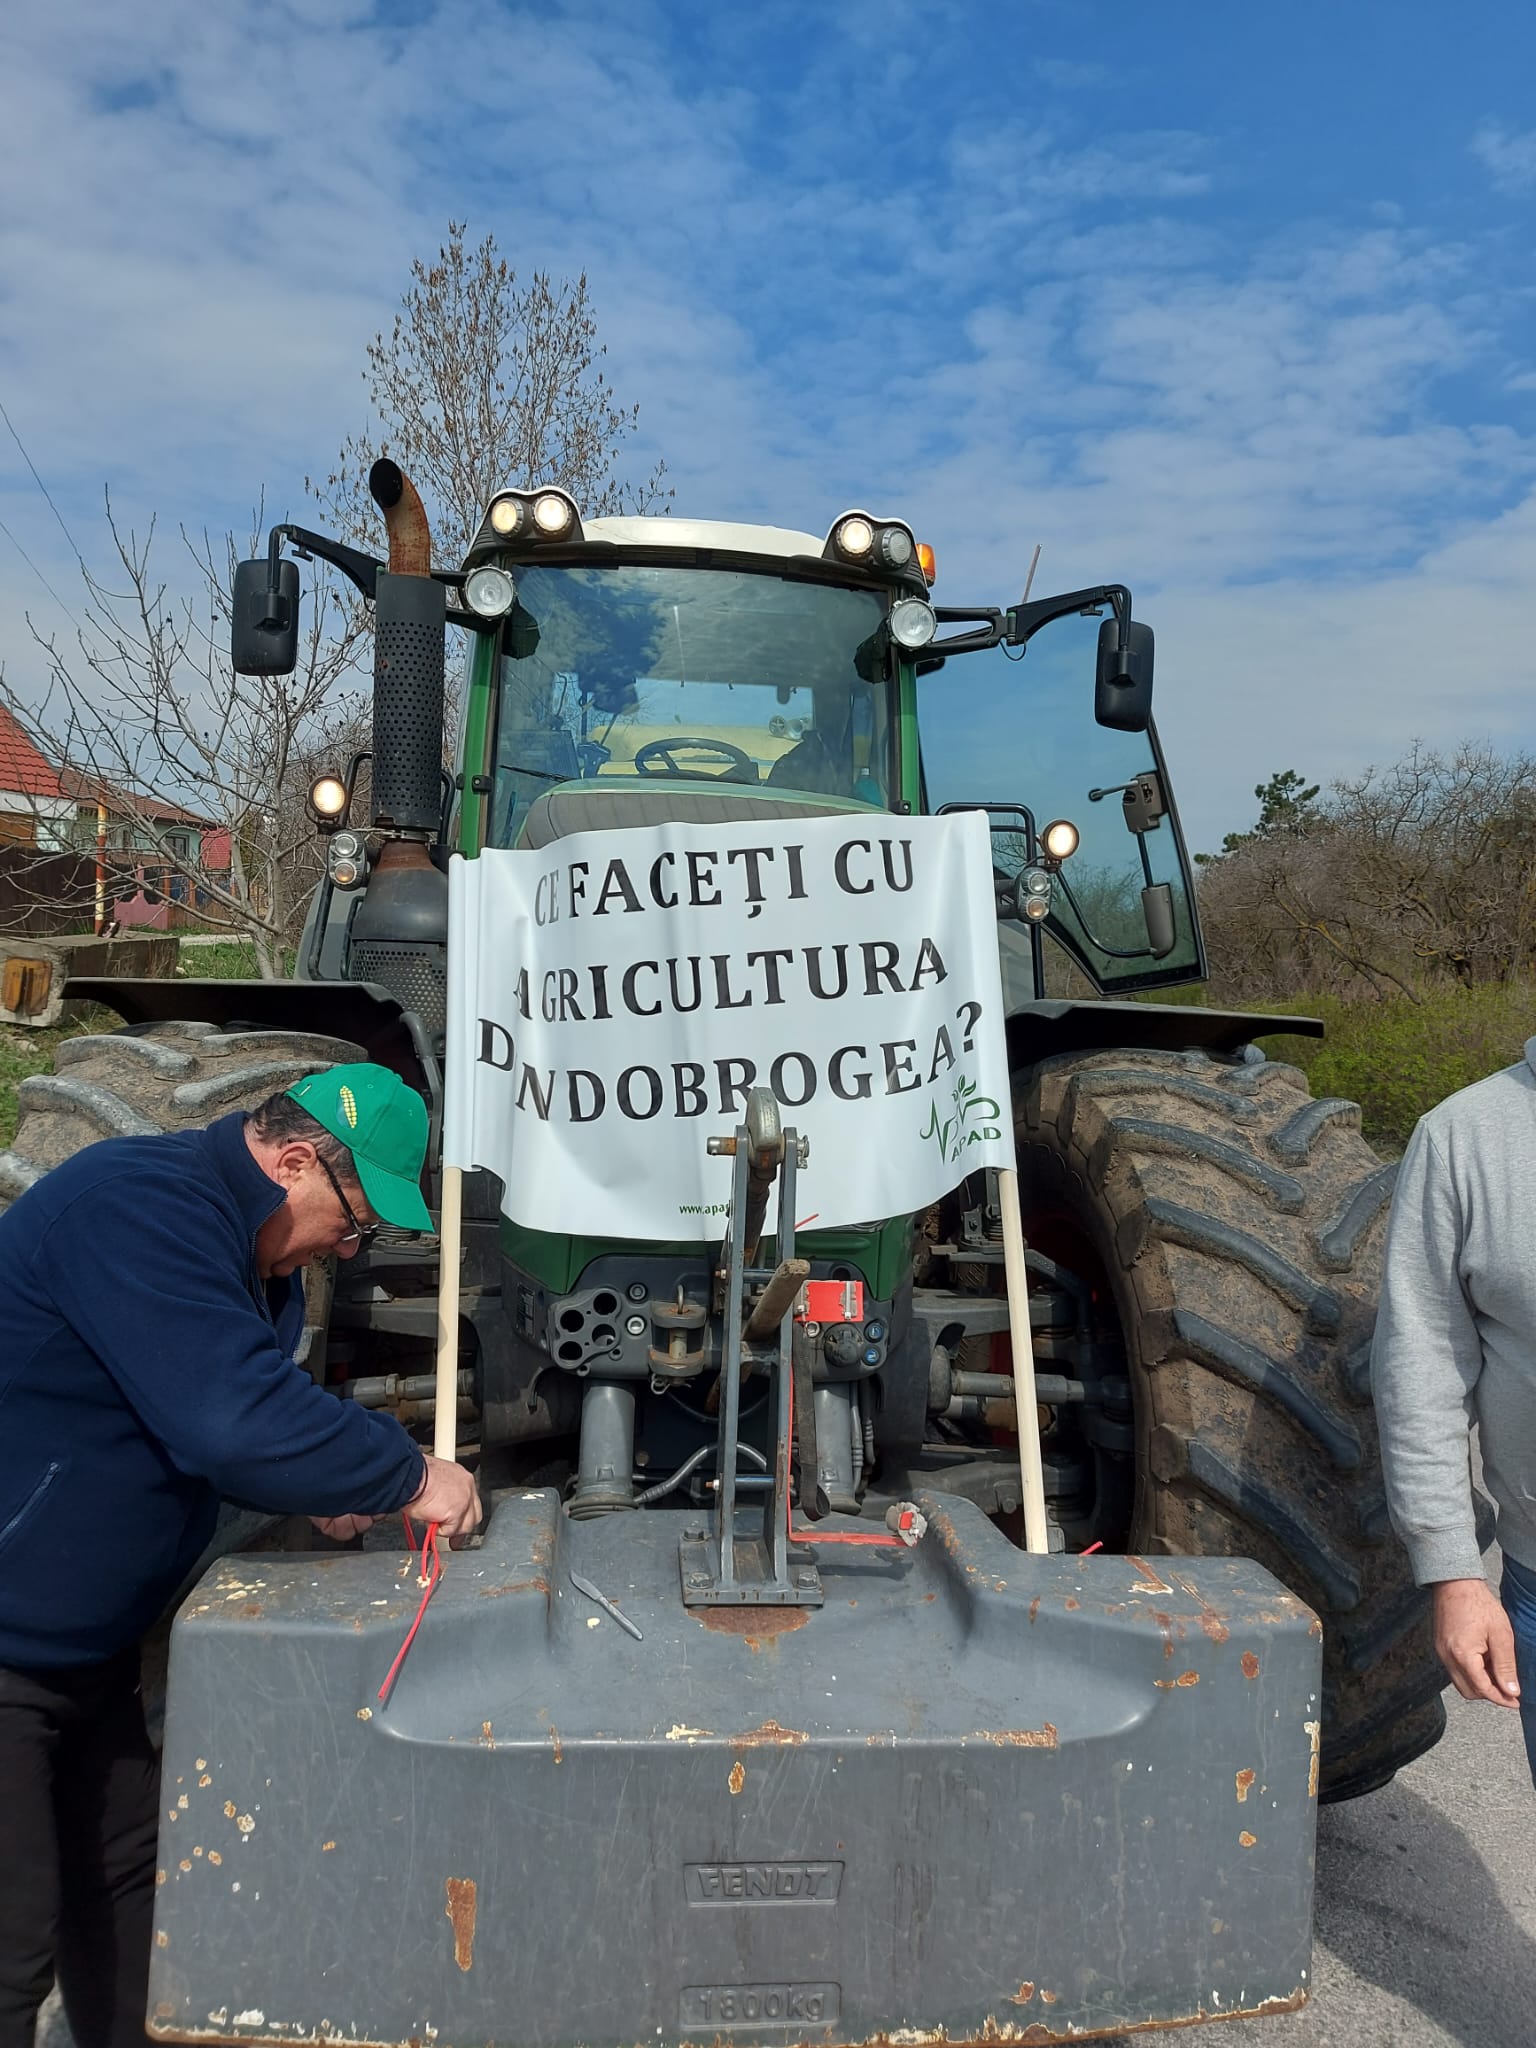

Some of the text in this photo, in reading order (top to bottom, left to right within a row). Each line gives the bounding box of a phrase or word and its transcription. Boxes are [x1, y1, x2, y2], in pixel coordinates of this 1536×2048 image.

[534, 868, 560, 927] CE
[834, 839, 914, 895] CU
[513, 937, 948, 1023] AGRICULTURA
[477, 1001, 983, 1122] DN DOBROGEA?
[951, 1126, 1002, 1163] APAD
[698, 1867, 829, 1898] FENDT
[700, 1985, 826, 2023] 1800kg
